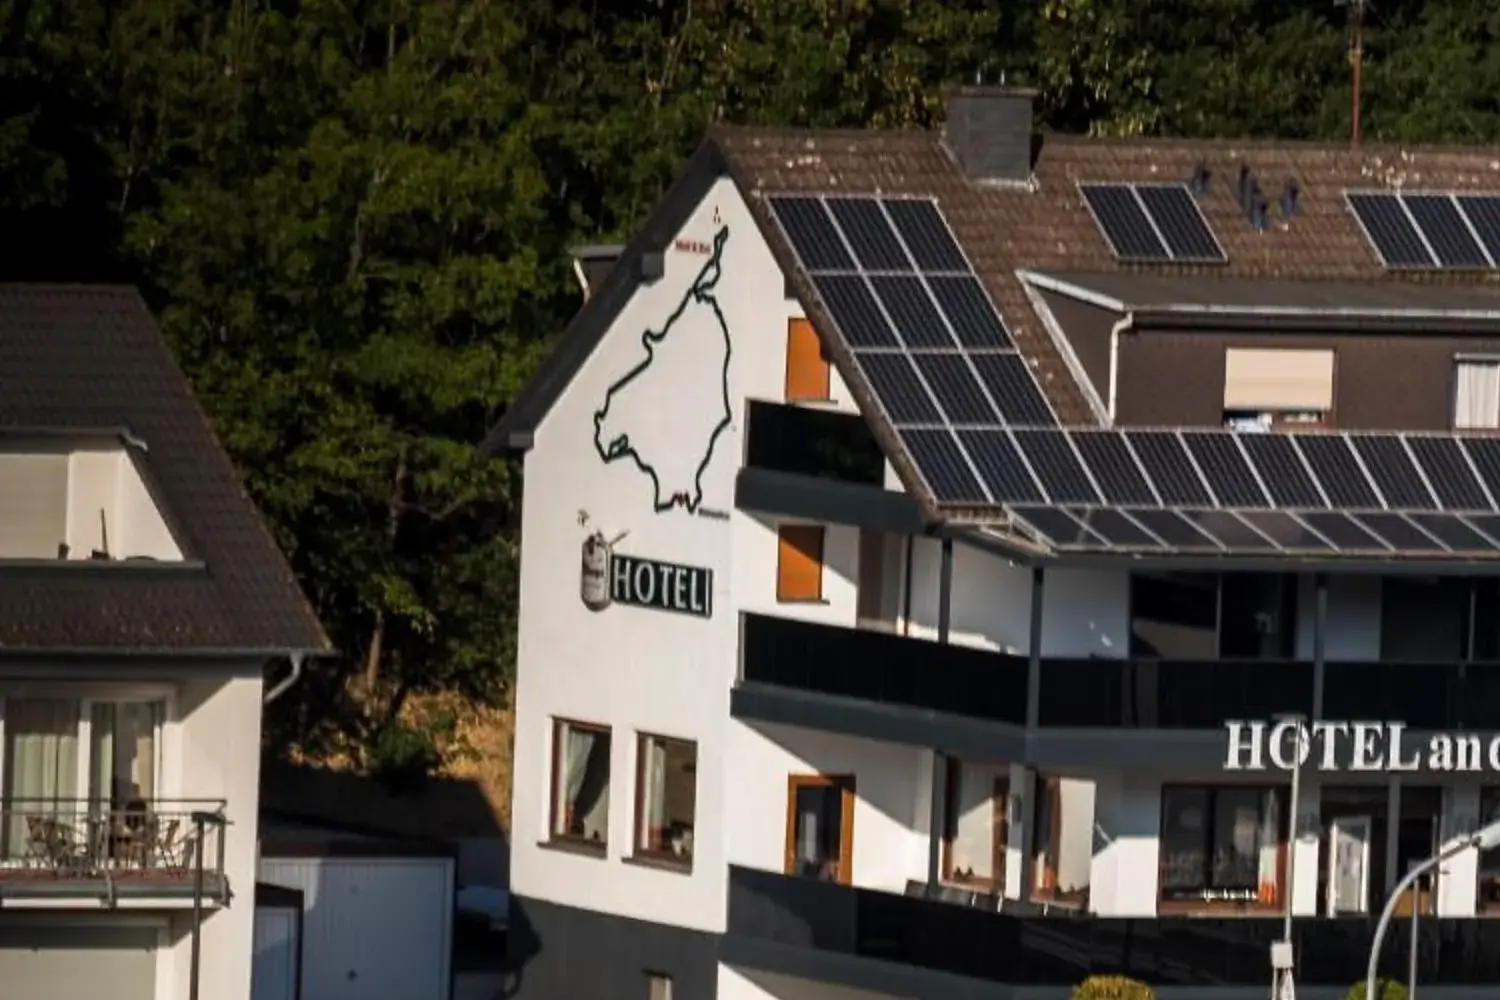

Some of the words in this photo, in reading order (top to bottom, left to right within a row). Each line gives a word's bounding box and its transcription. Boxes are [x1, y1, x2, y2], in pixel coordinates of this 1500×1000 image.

[613, 558, 703, 611] HOTEL
[1223, 719, 1421, 772] HOTEL
[1429, 733, 1483, 773] an
